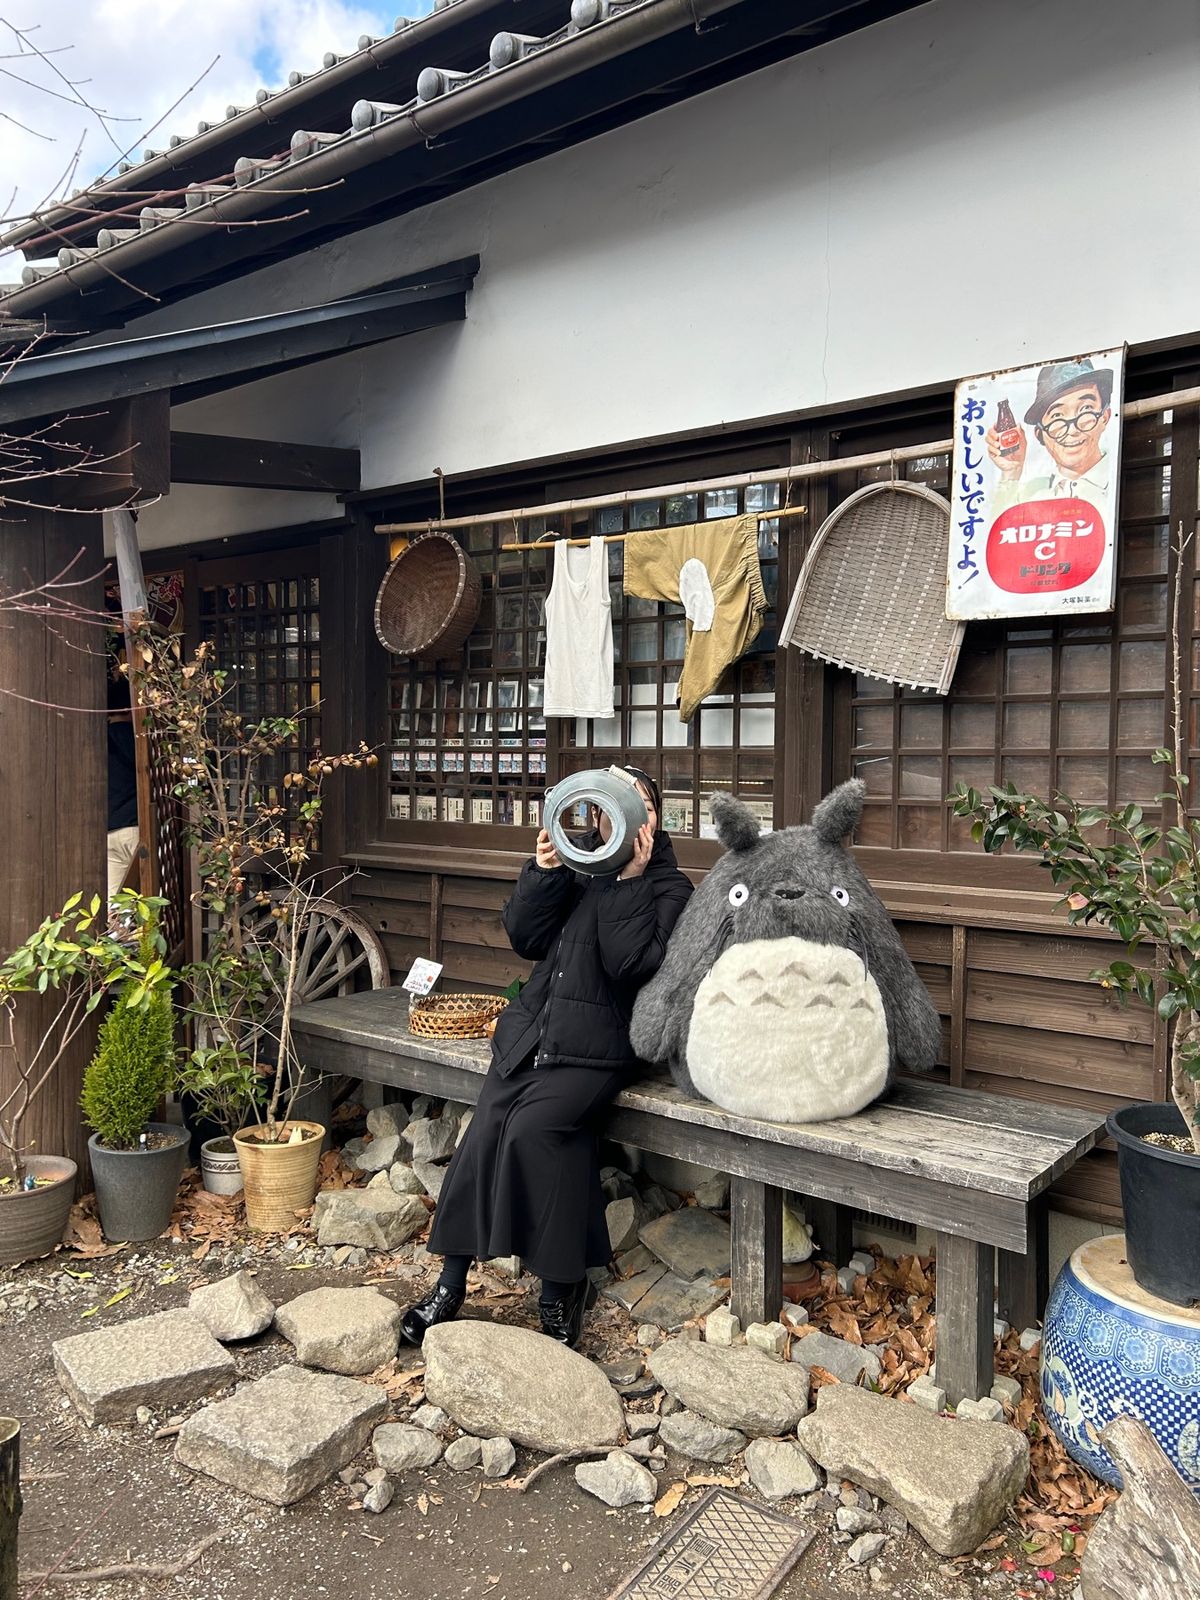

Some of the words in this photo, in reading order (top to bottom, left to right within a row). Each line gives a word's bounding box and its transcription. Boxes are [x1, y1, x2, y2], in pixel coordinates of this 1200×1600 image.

[957, 398, 986, 590] おいしいですよ！
[1000, 519, 1094, 545] オロナミン
[1034, 542, 1056, 560] C
[1020, 562, 1071, 577] ドリンク
